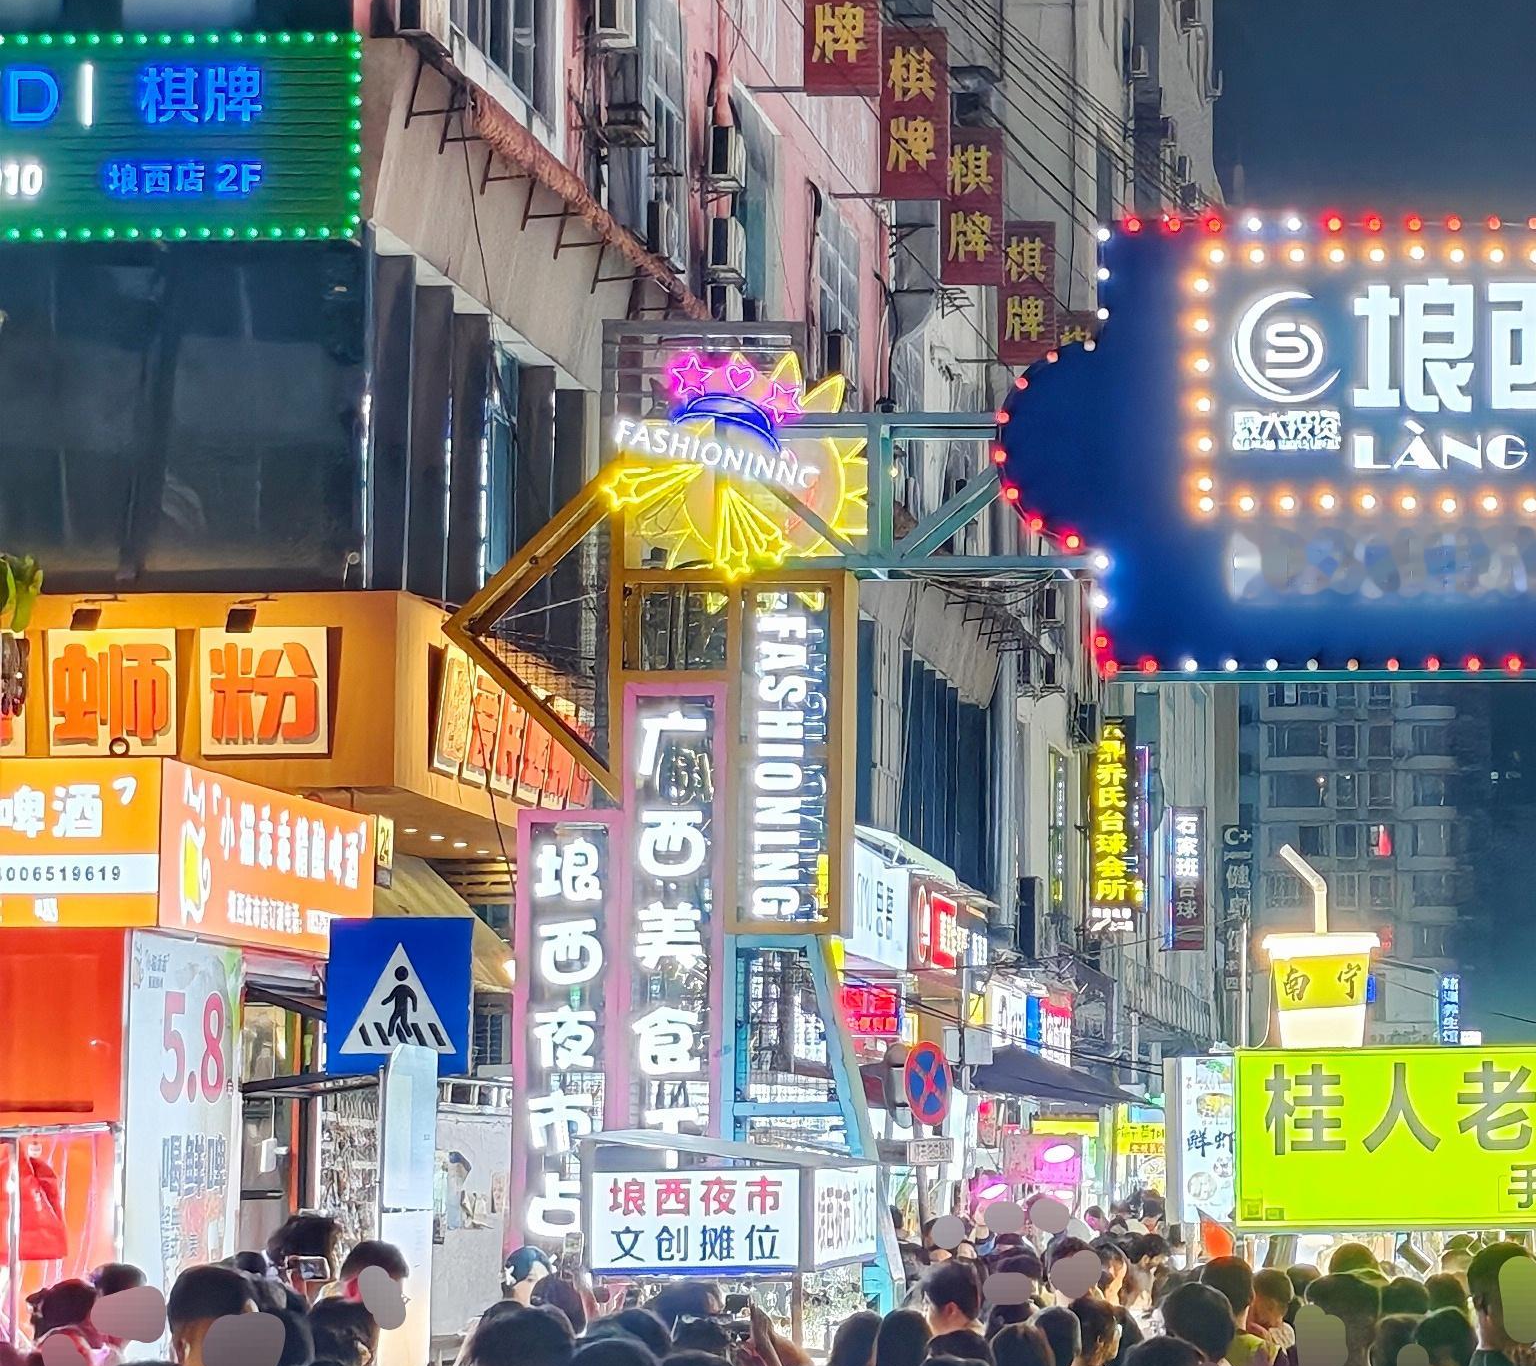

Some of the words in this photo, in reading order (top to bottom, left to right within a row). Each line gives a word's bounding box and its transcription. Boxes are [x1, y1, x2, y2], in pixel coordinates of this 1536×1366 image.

[141, 66, 262, 122] 棋牌
[887, 46, 936, 172] 棋牌
[0, 164, 43, 196] 10
[108, 163, 205, 194] 埌西店
[215, 164, 262, 194] 2F
[948, 144, 993, 262] 棋牌
[1004, 236, 1047, 341] 棋牌
[1353, 420, 1529, 470] LÀNG
[0, 633, 319, 740] 蛳粉
[752, 617, 807, 917] FASHIONING
[0, 866, 121, 882] 006519619
[1283, 962, 1361, 1001] 南宁
[159, 990, 224, 1103] 5.8
[609, 1176, 783, 1217] 埌西夜市
[610, 1224, 781, 1263] 文创摊位
